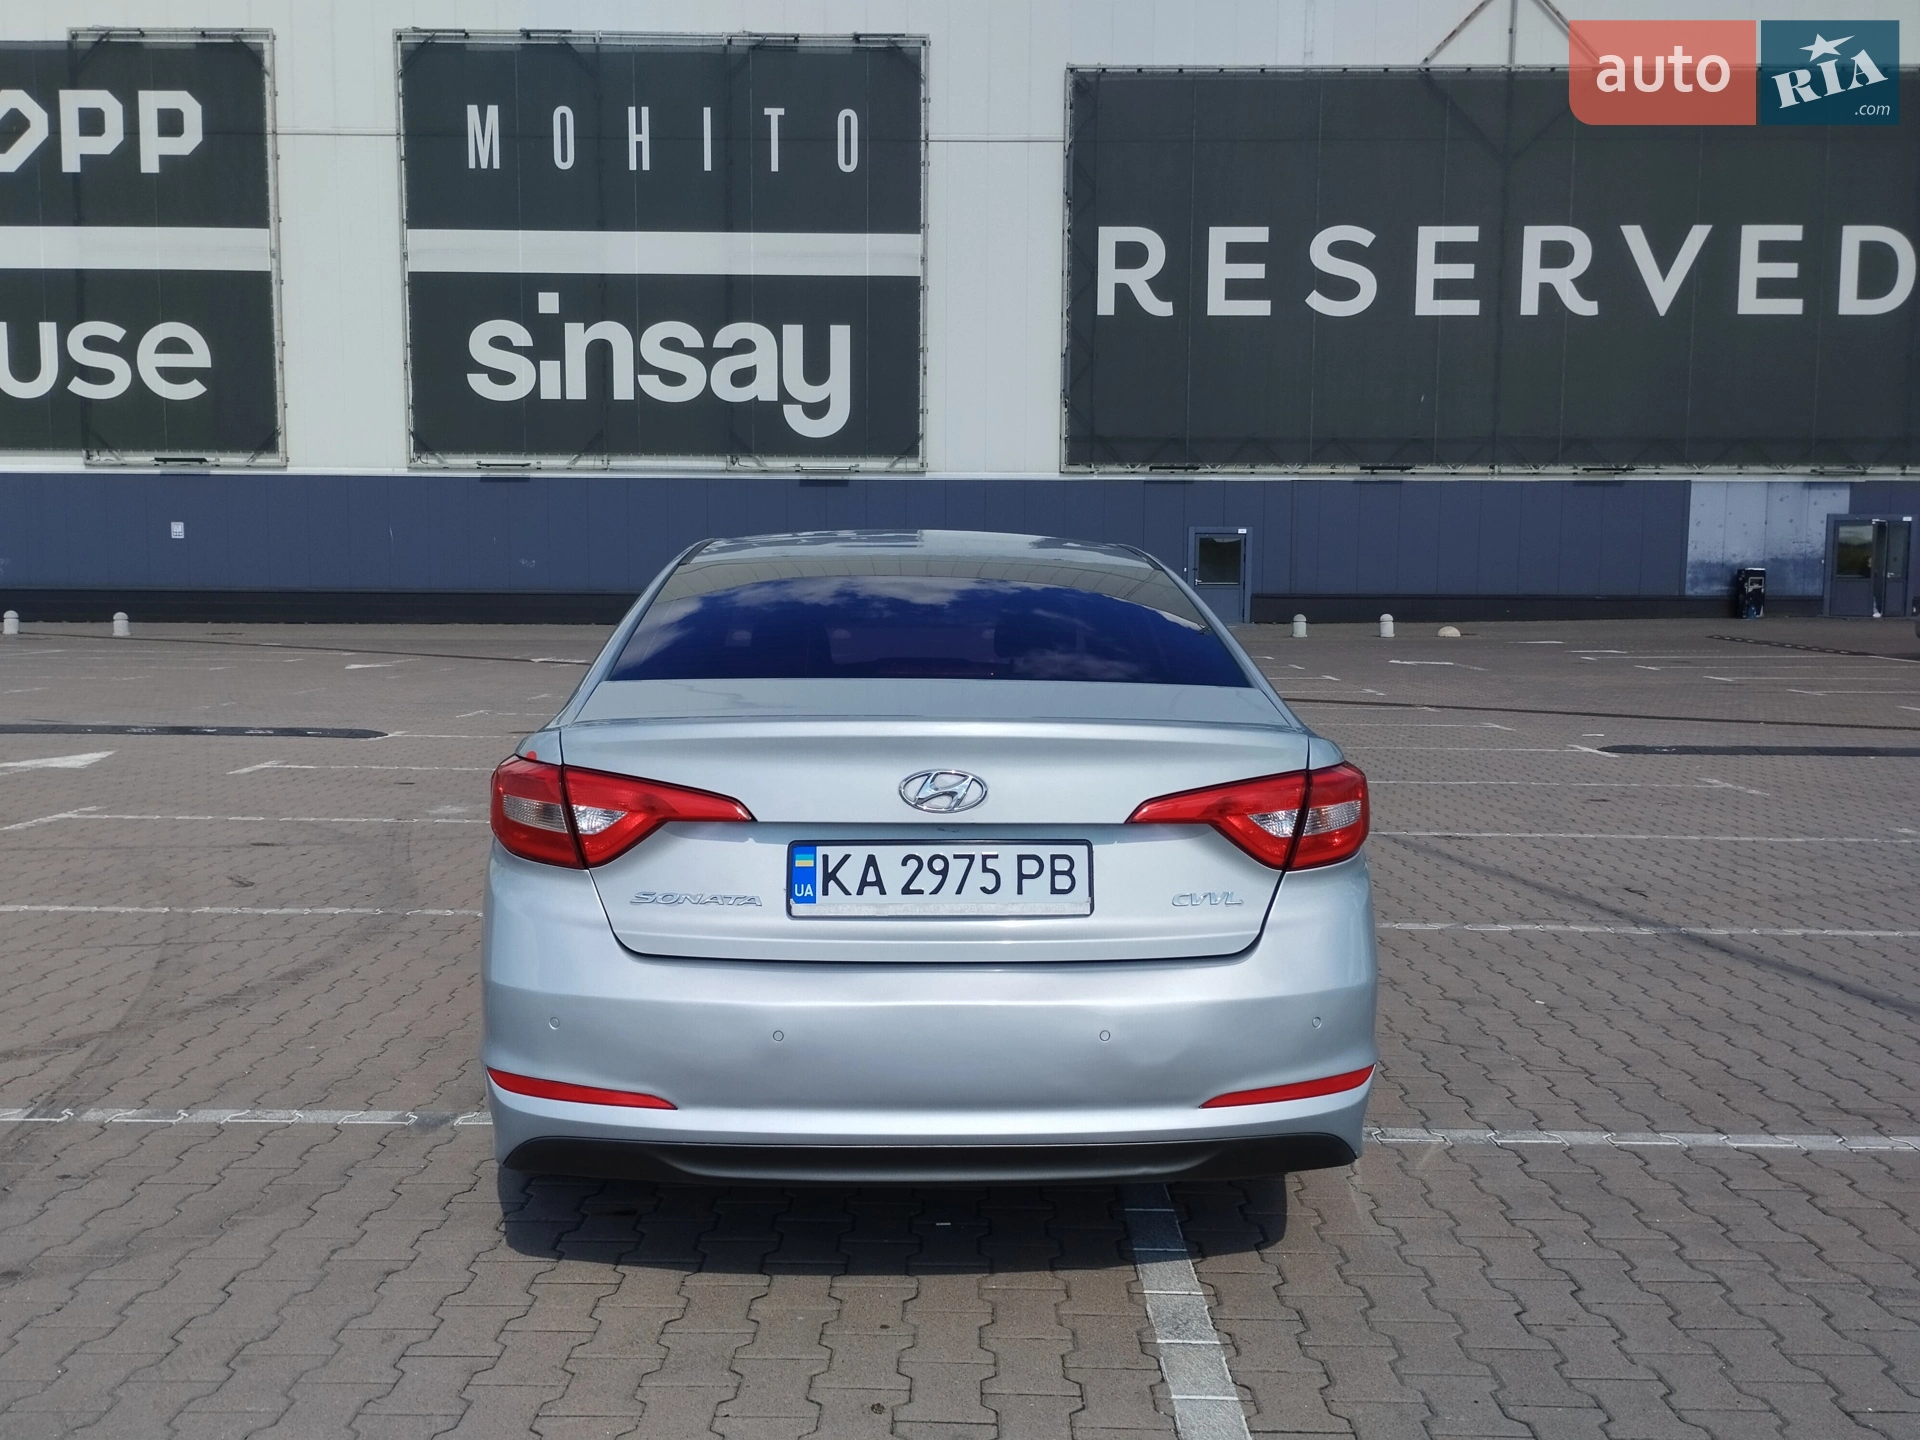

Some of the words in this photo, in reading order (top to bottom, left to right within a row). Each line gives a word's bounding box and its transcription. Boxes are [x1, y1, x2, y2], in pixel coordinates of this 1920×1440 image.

[466, 104, 859, 173] MOHITO
[1096, 224, 1917, 317] RESERVED
[466, 291, 851, 438] sinsay
[630, 891, 763, 907] SONATA
[795, 884, 814, 897] UA
[821, 853, 887, 897] KA
[900, 852, 1001, 896] 2975
[1016, 853, 1077, 896] PB
